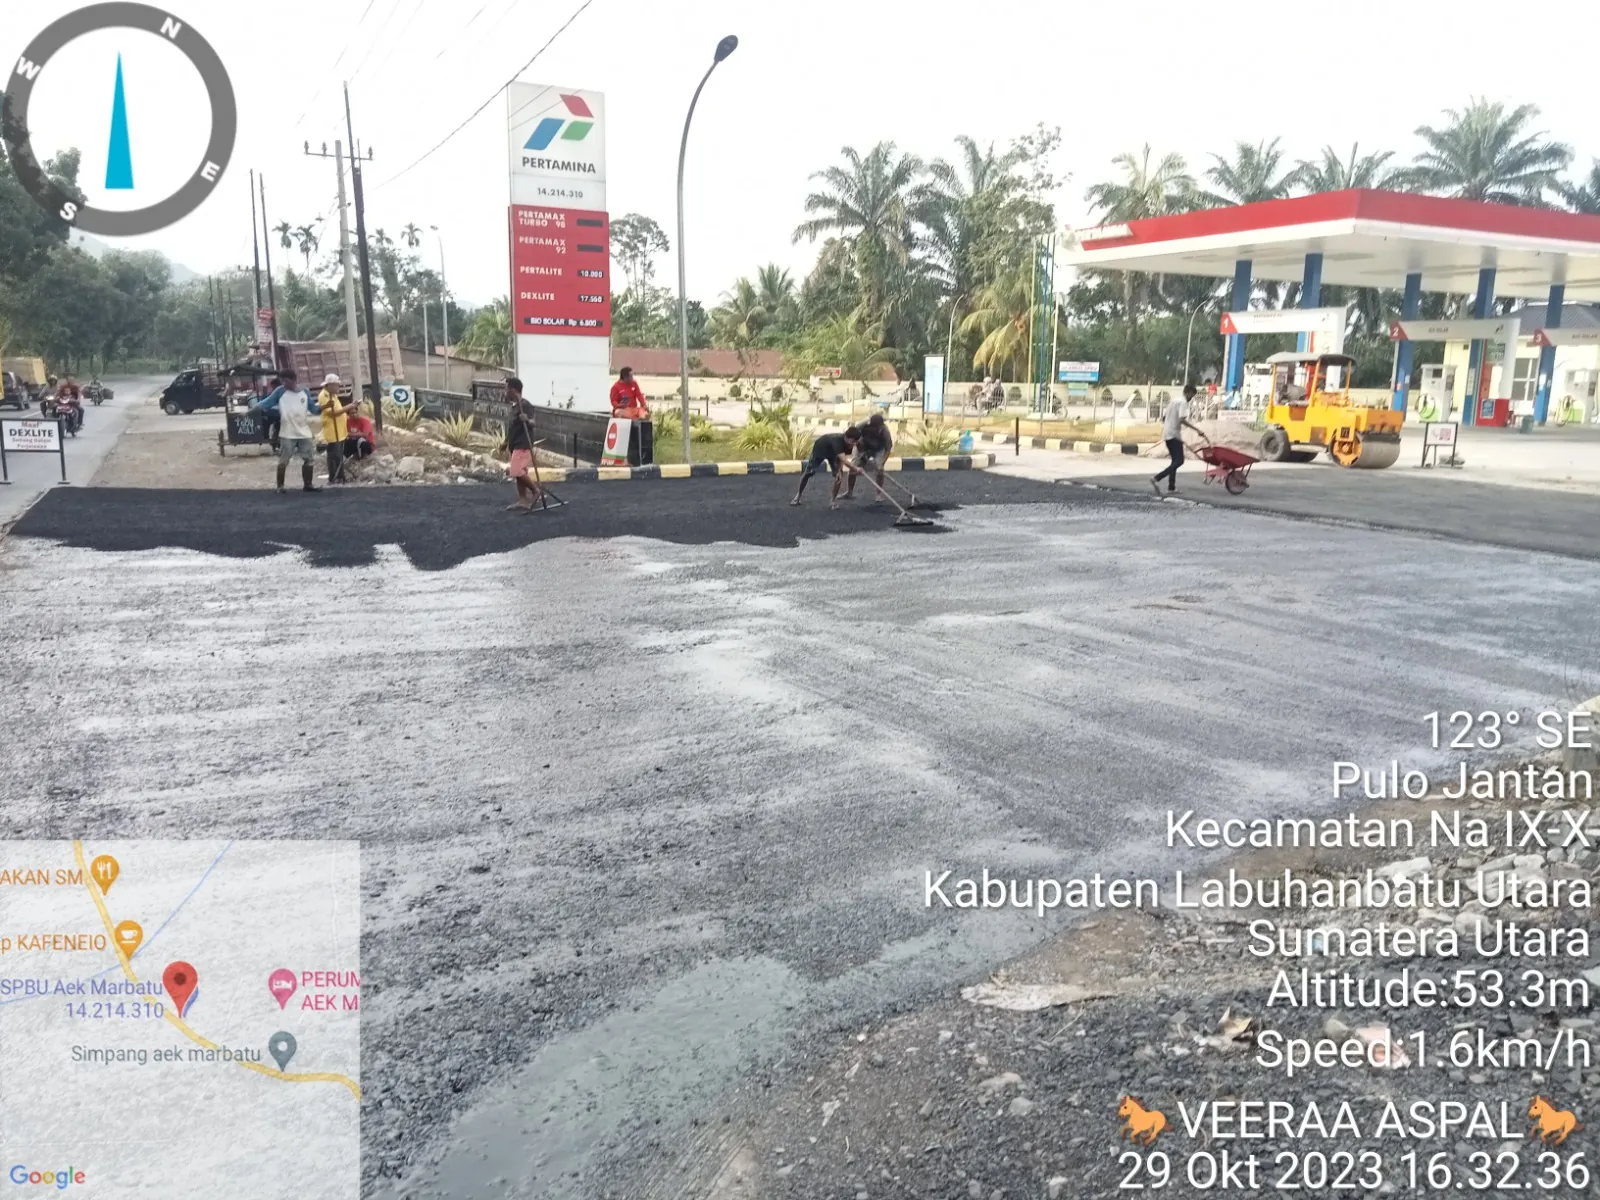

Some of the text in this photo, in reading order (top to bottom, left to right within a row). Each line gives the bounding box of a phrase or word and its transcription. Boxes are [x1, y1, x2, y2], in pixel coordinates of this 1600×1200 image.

[522, 156, 597, 174] PERTAMINA
[537, 187, 584, 199] 14.214.310
[518, 210, 566, 221] PERTAMAX
[519, 218, 548, 227] TURBO
[519, 236, 566, 247] PERTAMAX
[555, 246, 567, 254] 92
[520, 266, 603, 278] PERTALITE 10.000
[521, 292, 555, 301] DEXLITE
[530, 316, 542, 325] BIO
[543, 317, 565, 326] SOLAR
[568, 318, 577, 327] Rp
[1223, 317, 1230, 329] 1
[1393, 326, 1399, 337] 2
[1535, 333, 1542, 344] 3
[9, 428, 54, 438] DEXLITE
